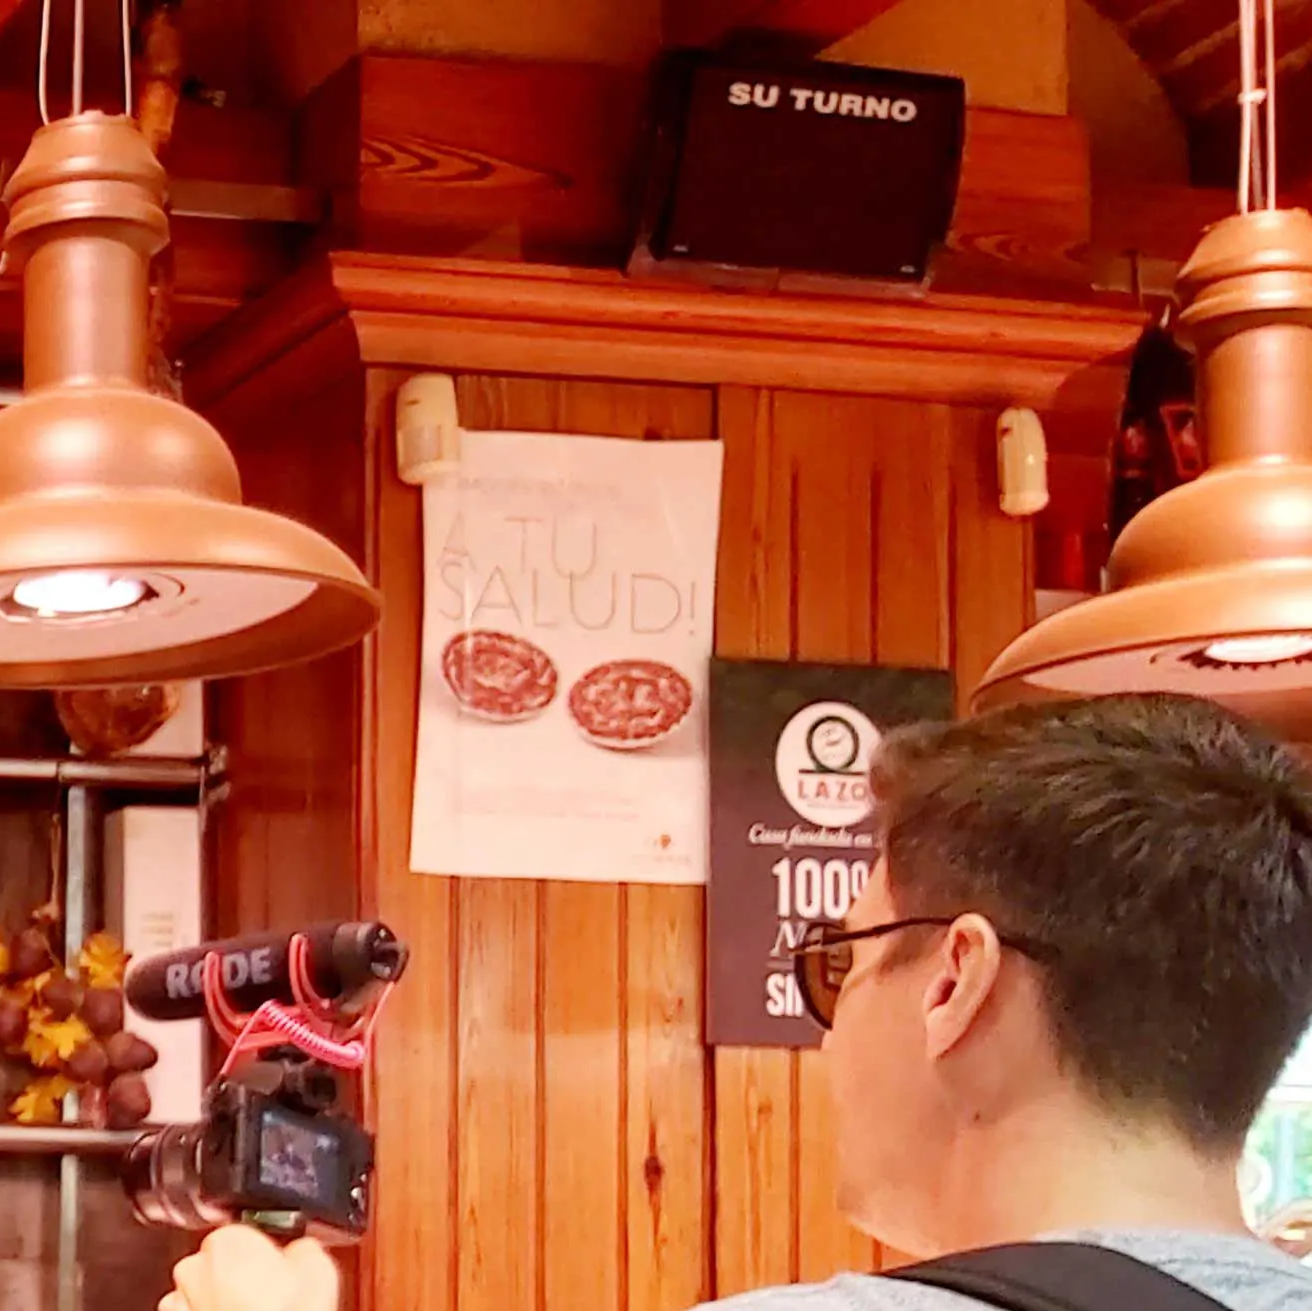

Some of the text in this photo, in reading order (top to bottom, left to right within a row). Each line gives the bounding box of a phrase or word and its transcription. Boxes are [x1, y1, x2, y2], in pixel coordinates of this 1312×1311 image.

[727, 82, 918, 123] SU TURNO
[437, 510, 598, 581] A TU
[438, 563, 698, 637] SALUD!
[797, 779, 868, 802] LAZO
